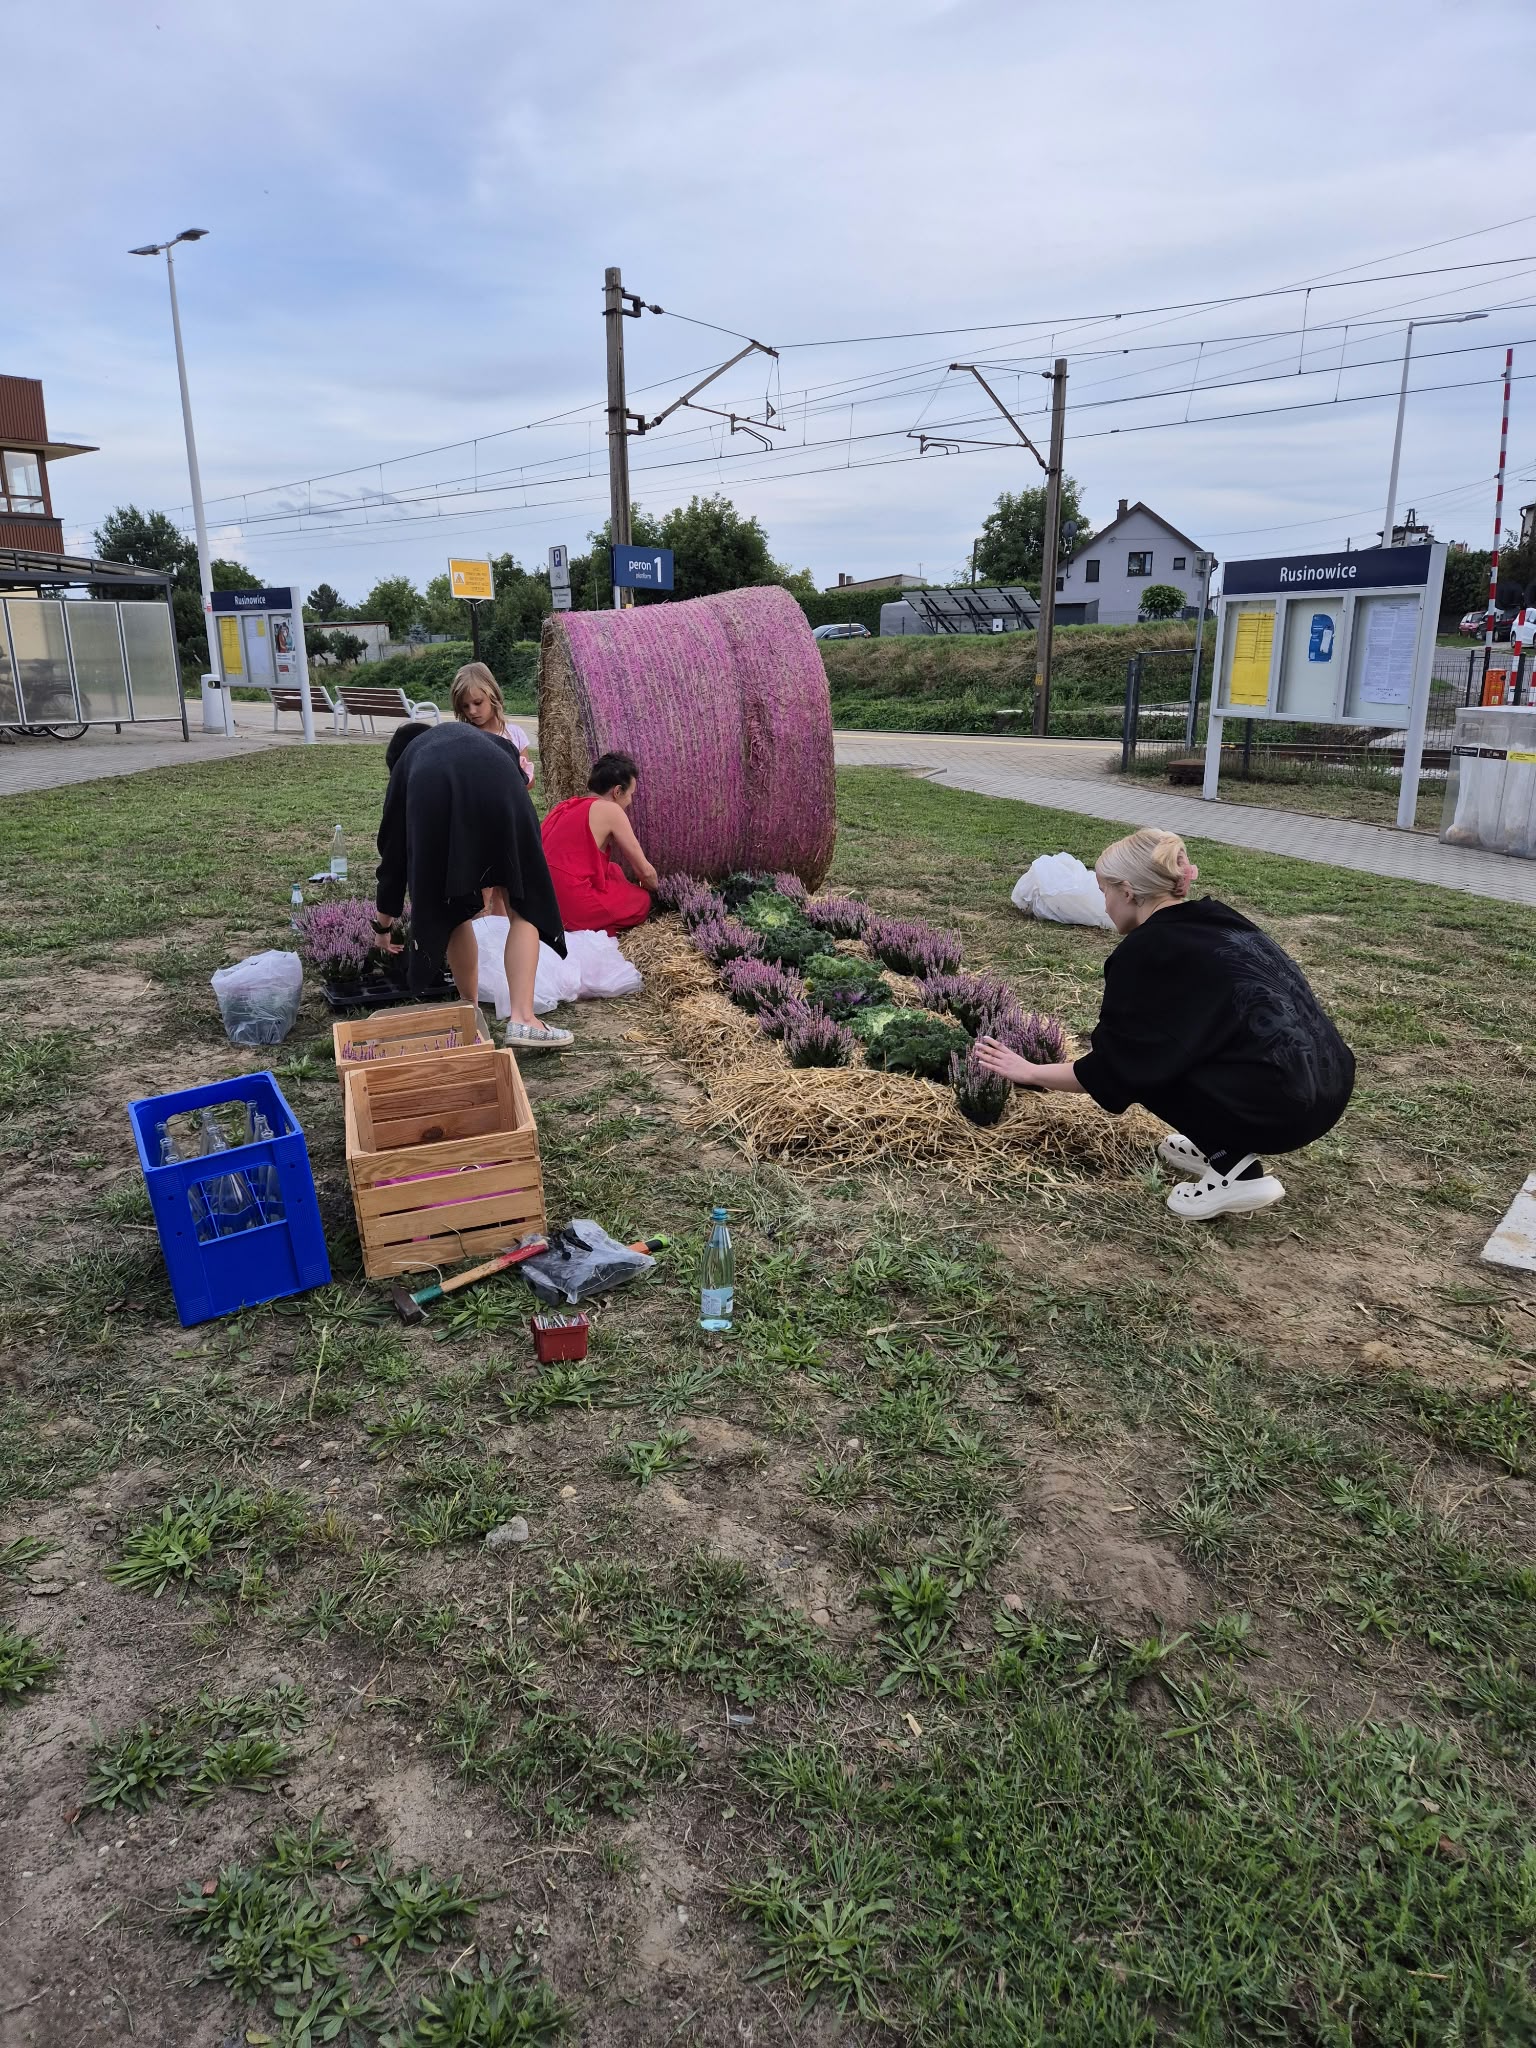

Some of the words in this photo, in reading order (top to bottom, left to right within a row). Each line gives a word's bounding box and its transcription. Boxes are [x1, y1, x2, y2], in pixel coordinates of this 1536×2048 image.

[628, 560, 652, 572] peron
[653, 556, 662, 583] 1
[1279, 562, 1357, 583] Rusinowice
[234, 594, 266, 606] Rusinowice
